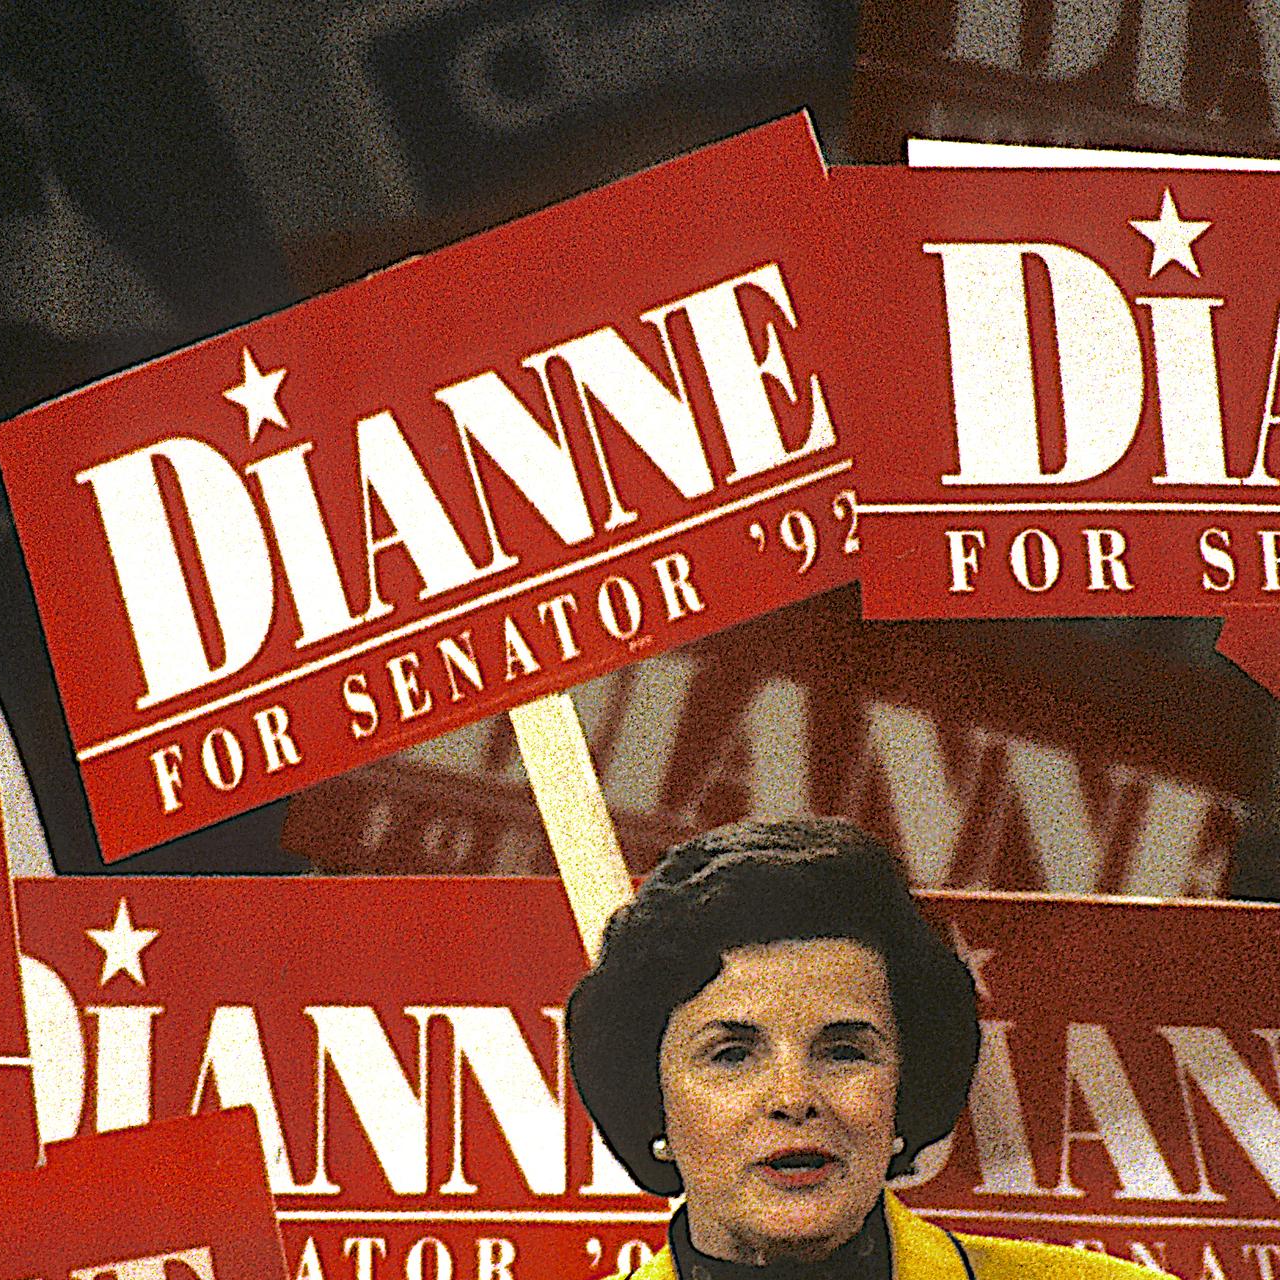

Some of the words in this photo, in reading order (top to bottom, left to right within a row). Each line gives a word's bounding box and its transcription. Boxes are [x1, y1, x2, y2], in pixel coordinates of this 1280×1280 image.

[76, 261, 838, 709] DIANNE
[947, 526, 1136, 595] FOR
[149, 703, 303, 815] FOR
[343, 549, 705, 740] SENATOR
